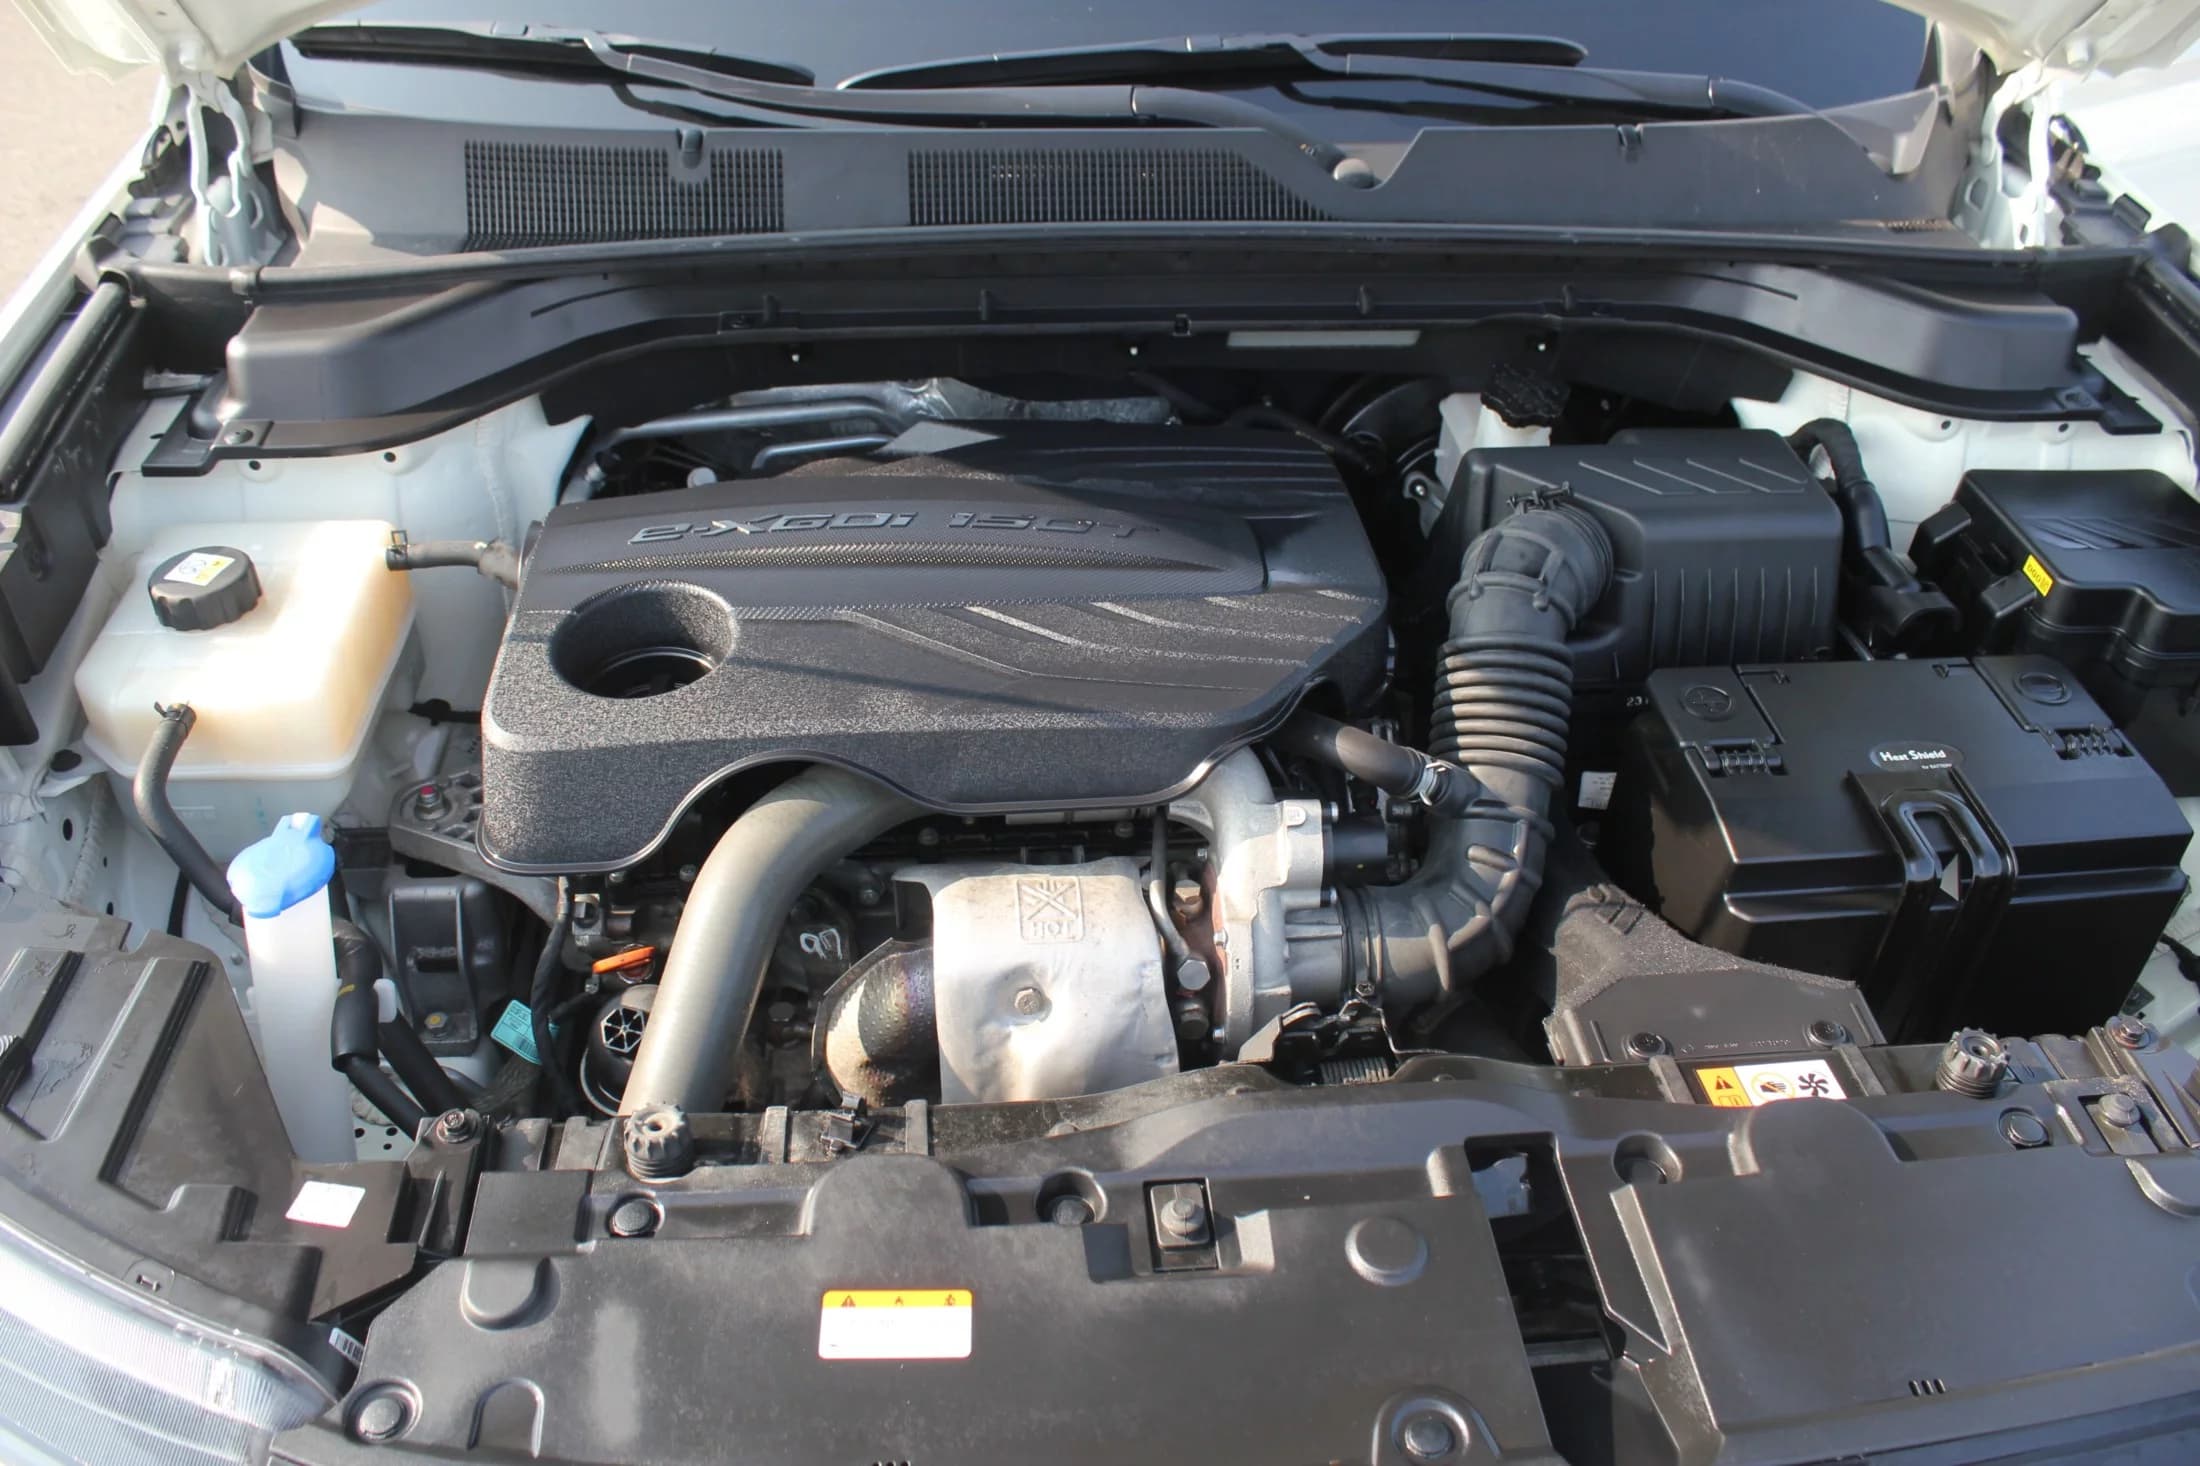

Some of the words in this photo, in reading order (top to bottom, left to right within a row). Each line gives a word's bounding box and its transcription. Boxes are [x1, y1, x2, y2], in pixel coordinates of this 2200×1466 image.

[1879, 751, 1909, 762] Heat
[1908, 749, 1947, 761] Shield
[1031, 920, 1076, 938] HOT
